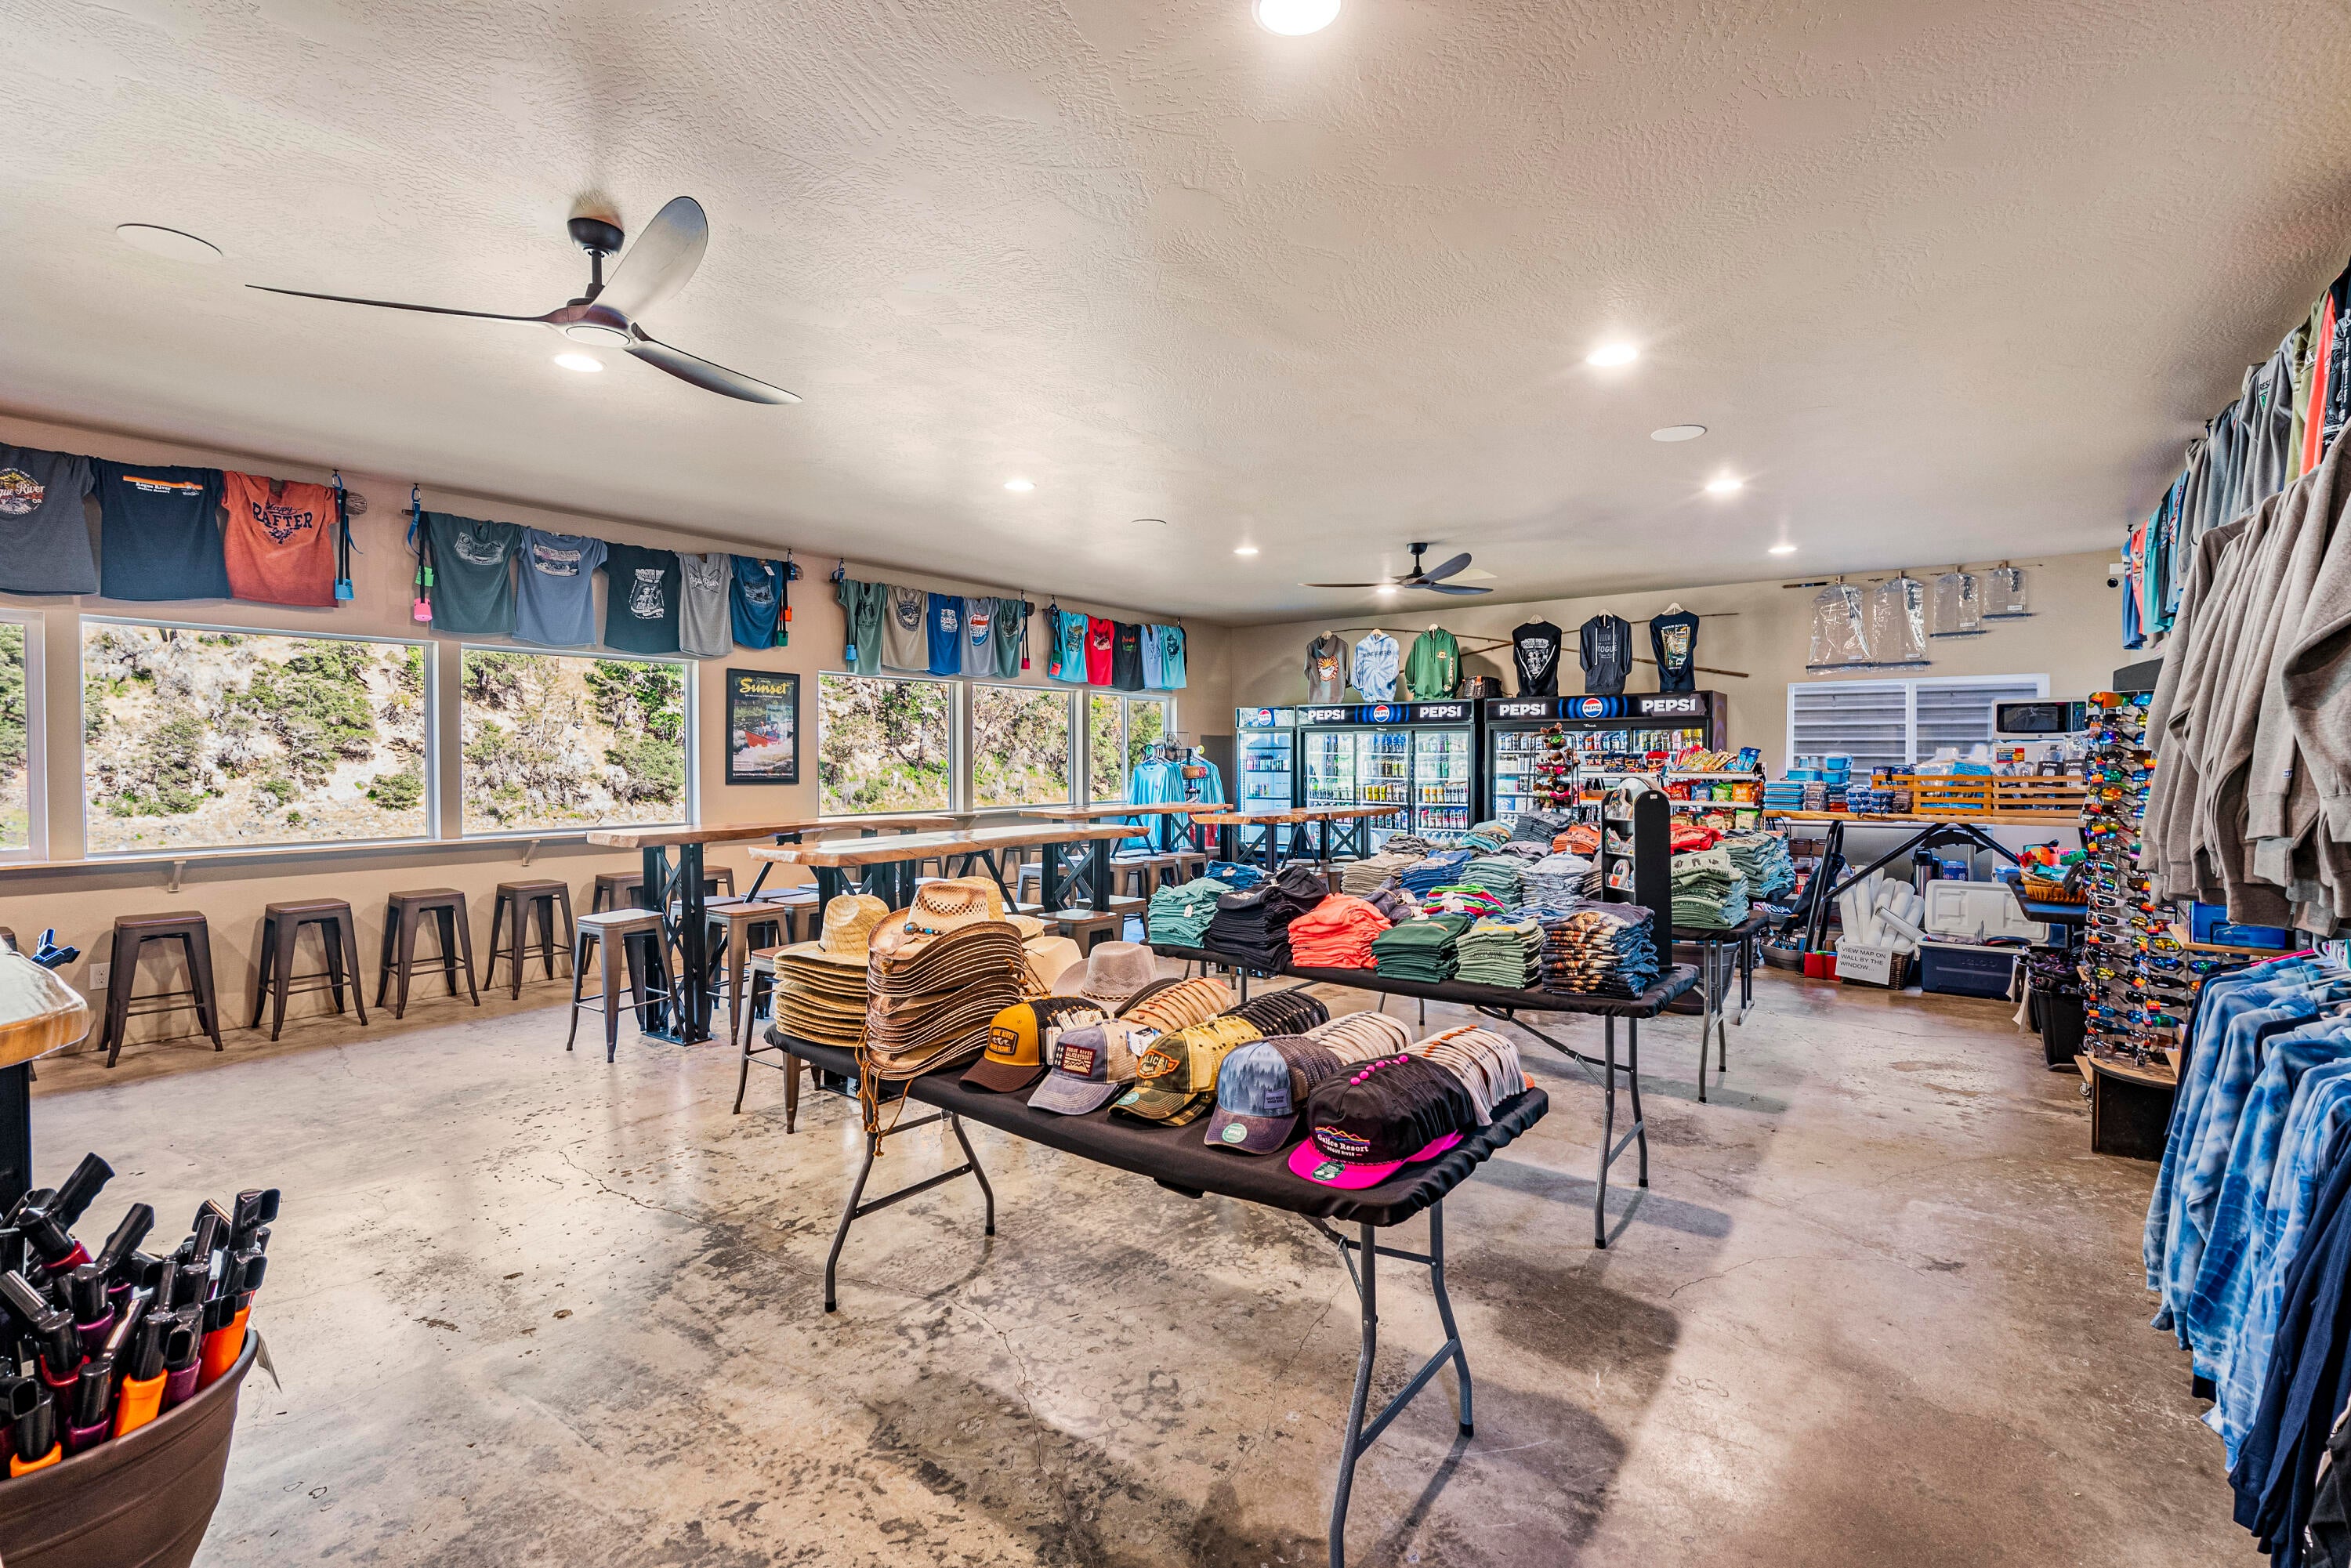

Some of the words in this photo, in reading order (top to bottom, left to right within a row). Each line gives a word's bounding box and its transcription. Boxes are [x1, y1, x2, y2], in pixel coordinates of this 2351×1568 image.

[16, 481, 45, 494] River
[252, 502, 313, 529] RAFTER
[739, 677, 791, 695] Sunset
[1499, 704, 1546, 716] PEPSI
[1643, 699, 1696, 712] PEPSI
[1308, 709, 1345, 720] PEPSI
[1419, 706, 1462, 718] PEPSI
[1001, 1030, 1014, 1041] RIVER
[1317, 1134, 1339, 1148] Galice
[1339, 1143, 1369, 1152] Resort
[1327, 1146, 1341, 1154] ROGUE
